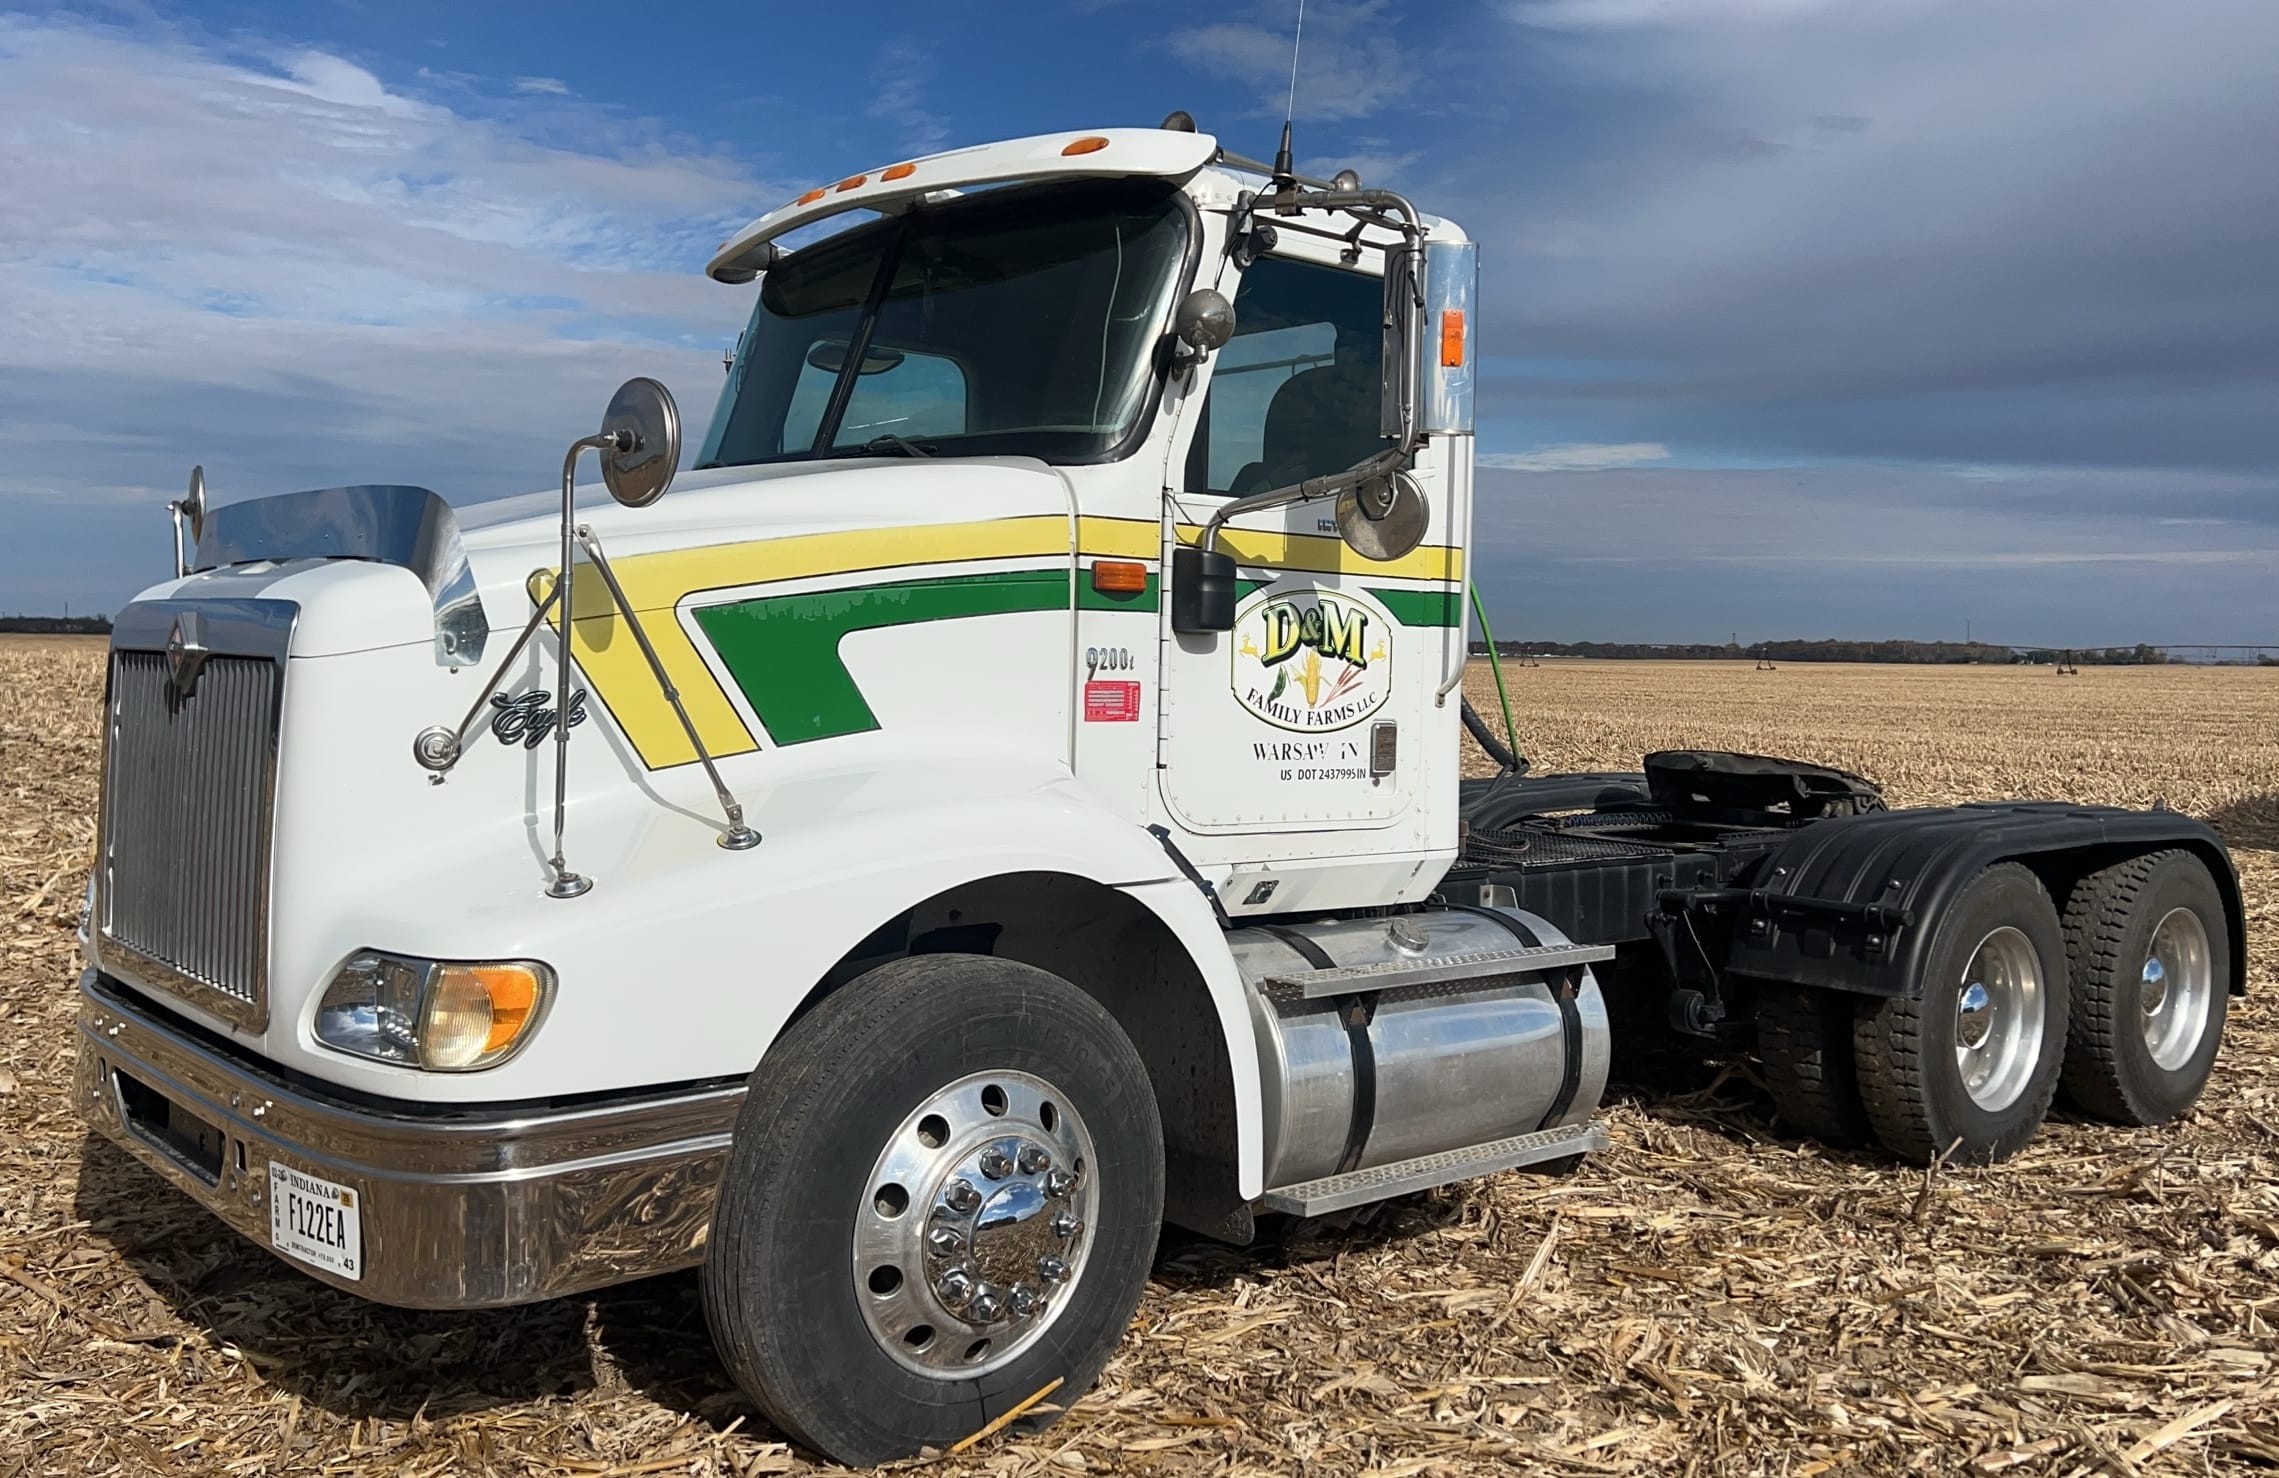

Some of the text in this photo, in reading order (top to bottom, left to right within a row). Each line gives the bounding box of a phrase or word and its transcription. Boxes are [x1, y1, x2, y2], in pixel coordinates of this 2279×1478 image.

[1261, 599, 1369, 670] D&M
[1246, 688, 1378, 726] FAMILY FARMS LLC
[1280, 769, 1292, 781] US
[1298, 768, 1316, 780] DOT
[290, 1174, 331, 1199] INDIANA
[289, 1192, 346, 1250] F122EA
[343, 1257, 354, 1271] 43
